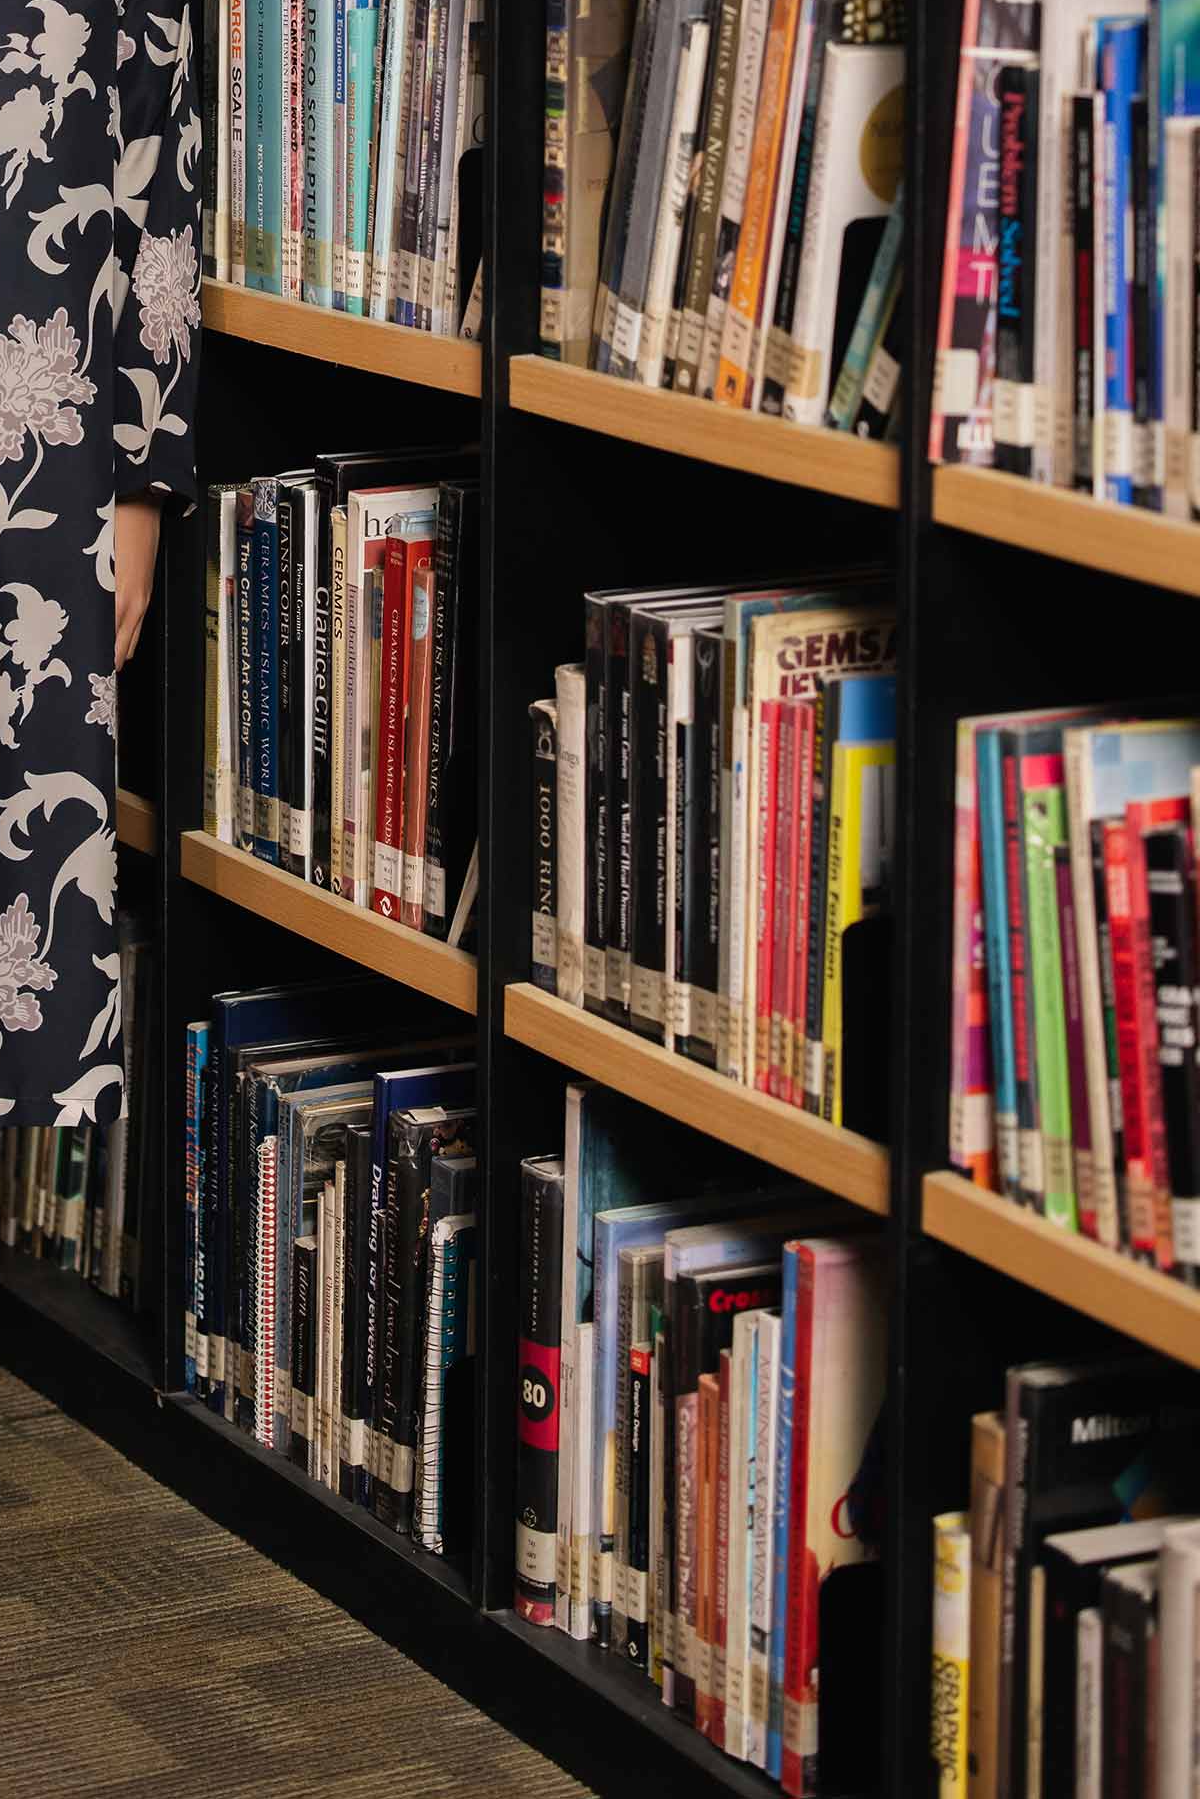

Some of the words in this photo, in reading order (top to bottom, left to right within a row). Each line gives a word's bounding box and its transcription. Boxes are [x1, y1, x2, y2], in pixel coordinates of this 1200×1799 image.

[282, 33, 290, 77] HUMAN
[290, 20, 299, 76] CARVING
[307, 8, 317, 88] DECO
[335, 18, 345, 100] Engineering
[438, 6, 448, 72] BREAKING
[717, 3, 739, 70] JEWELS
[231, 66, 242, 142] SCALE
[282, 81, 290, 119] FIGURE
[290, 106, 299, 153] WOOD
[347, 81, 356, 122] PAPER
[432, 99, 442, 142] MOULD
[347, 126, 356, 188] FOLDING
[700, 135, 725, 212] NIZAMS
[241, 541, 251, 571] The
[280, 513, 290, 574] HANS
[240, 577, 251, 623] Craft
[260, 531, 271, 631] CERAMICS
[296, 561, 304, 597] Persian
[334, 546, 344, 641] CERAMICS
[240, 626, 251, 659] and
[280, 579, 290, 648] COPER
[295, 598, 304, 642] Ceramics
[314, 586, 330, 691] Clarice
[435, 589, 447, 640] EARLY
[240, 660, 251, 686] Art
[390, 608, 400, 683] CERAMICS
[777, 631, 882, 671] GEMS
[240, 690, 250, 706] of
[260, 650, 271, 731] ISLAMIC
[389, 686, 398, 730] FROM
[432, 644, 444, 716] ISLAMIC
[239, 709, 251, 747] Clay
[313, 695, 329, 761] Cliff
[260, 736, 271, 795] WORL
[386, 733, 396, 794] ISLAMIC
[429, 719, 441, 810] CERAMICS
[384, 796, 393, 845] LANDS
[539, 777, 552, 850] 1000
[619, 813, 630, 842] World
[619, 860, 630, 889] Head
[829, 814, 842, 881] Berlin
[619, 890, 630, 949] Ornaments
[826, 890, 841, 981] Fashion
[368, 1162, 383, 1253] Drawing
[387, 1159, 401, 1288] Traditional
[298, 1263, 310, 1317] Adorn
[324, 1275, 334, 1335] Charming
[369, 1260, 379, 1290] for
[366, 1291, 378, 1386] jewelers
[383, 1290, 401, 1376] Jewelry
[383, 1381, 400, 1410] of
[522, 1380, 547, 1407] 80
[632, 1380, 643, 1416] Graphic
[754, 1355, 771, 1461] MAKING
[631, 1417, 642, 1453] Design
[752, 1492, 768, 1617] DRAWING
[940, 1661, 961, 1783] GRAPHIC
